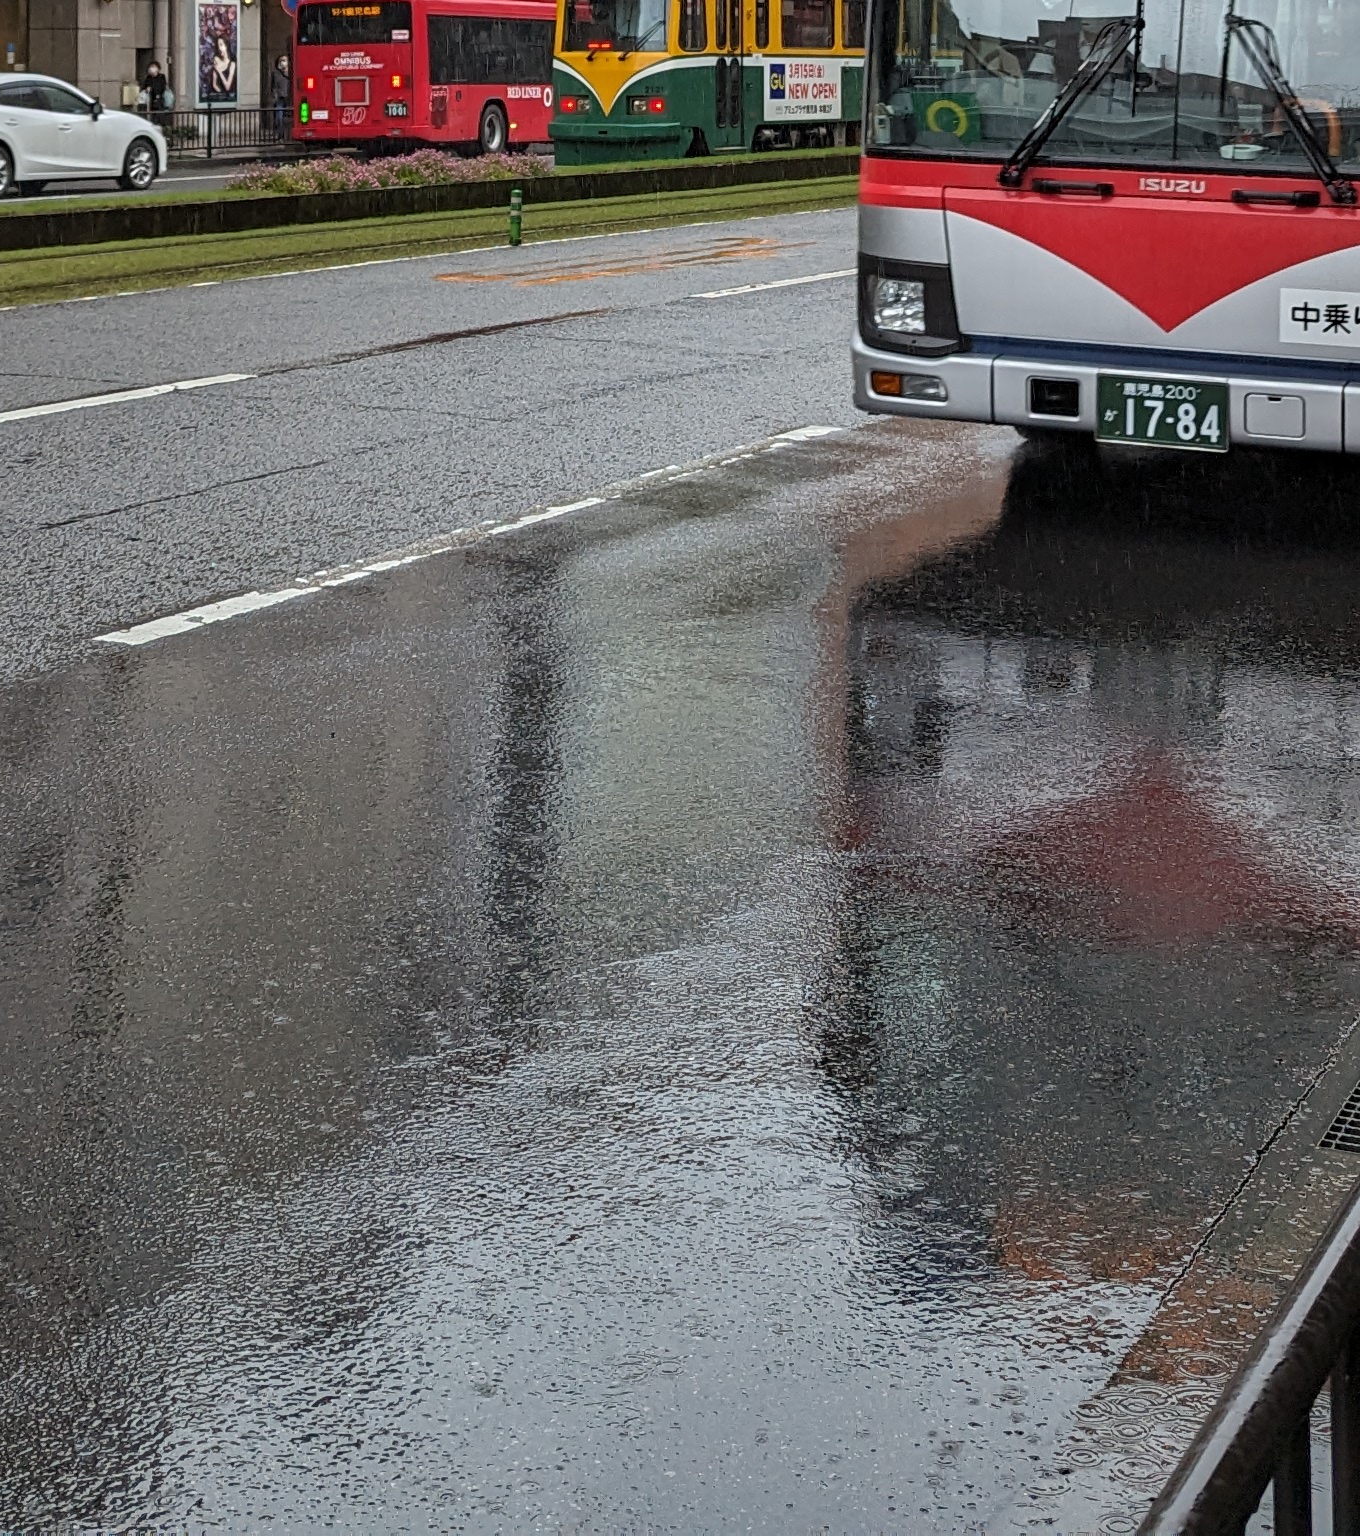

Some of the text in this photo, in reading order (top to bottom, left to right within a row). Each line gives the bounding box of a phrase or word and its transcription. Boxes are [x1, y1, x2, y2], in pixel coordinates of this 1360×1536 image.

[333, 57, 371, 65] OMNIBUS
[788, 63, 824, 78] 3月15日(金)
[770, 73, 785, 90] GU
[507, 87, 521, 98] RED
[522, 87, 541, 99] LINER
[788, 82, 837, 99] NEW OPEN!
[342, 107, 366, 125] 50
[1138, 177, 1207, 194] ISUZU
[1123, 382, 1197, 401] 鹿児島200
[1125, 399, 1220, 442] 17-84
